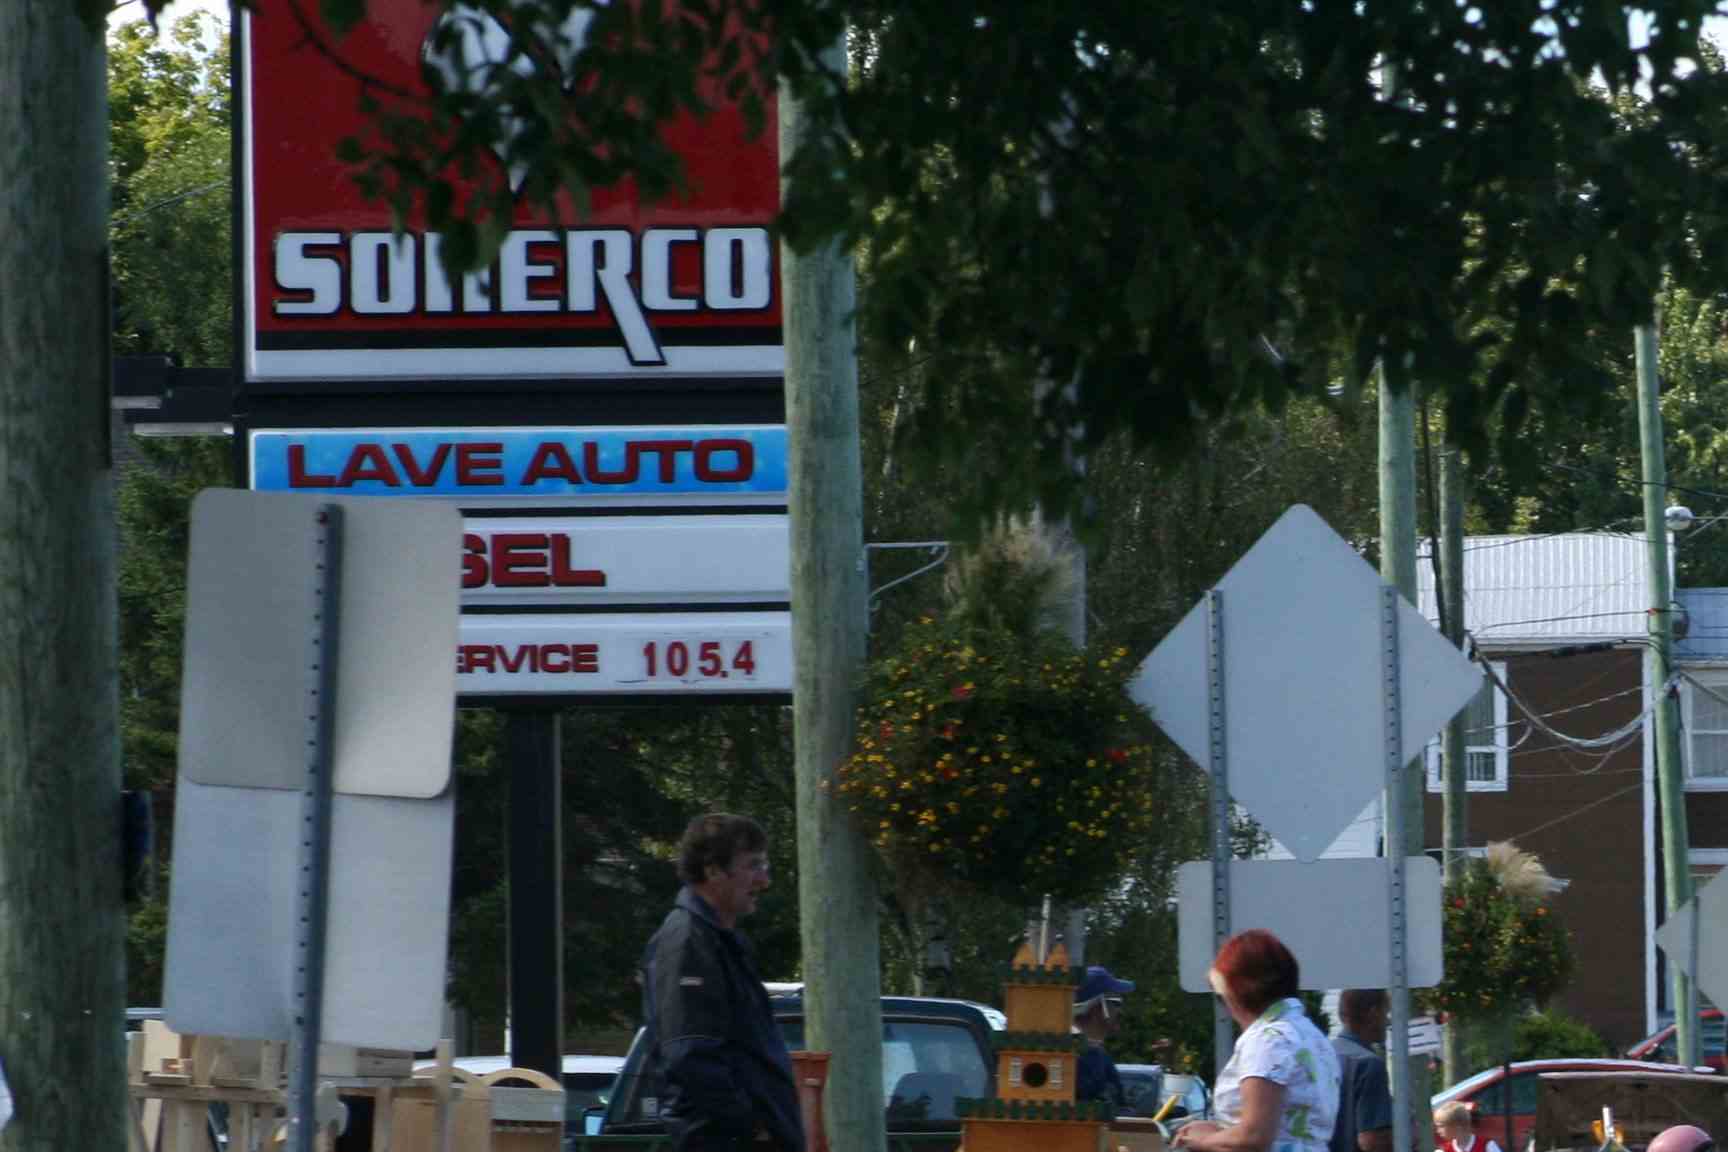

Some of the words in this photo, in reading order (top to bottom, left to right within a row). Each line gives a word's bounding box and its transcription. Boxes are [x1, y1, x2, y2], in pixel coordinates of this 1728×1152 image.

[288, 443, 504, 488] LAVE
[520, 439, 754, 485] AUTO
[457, 643, 599, 673] RVICE
[643, 640, 755, 678] 105.4
